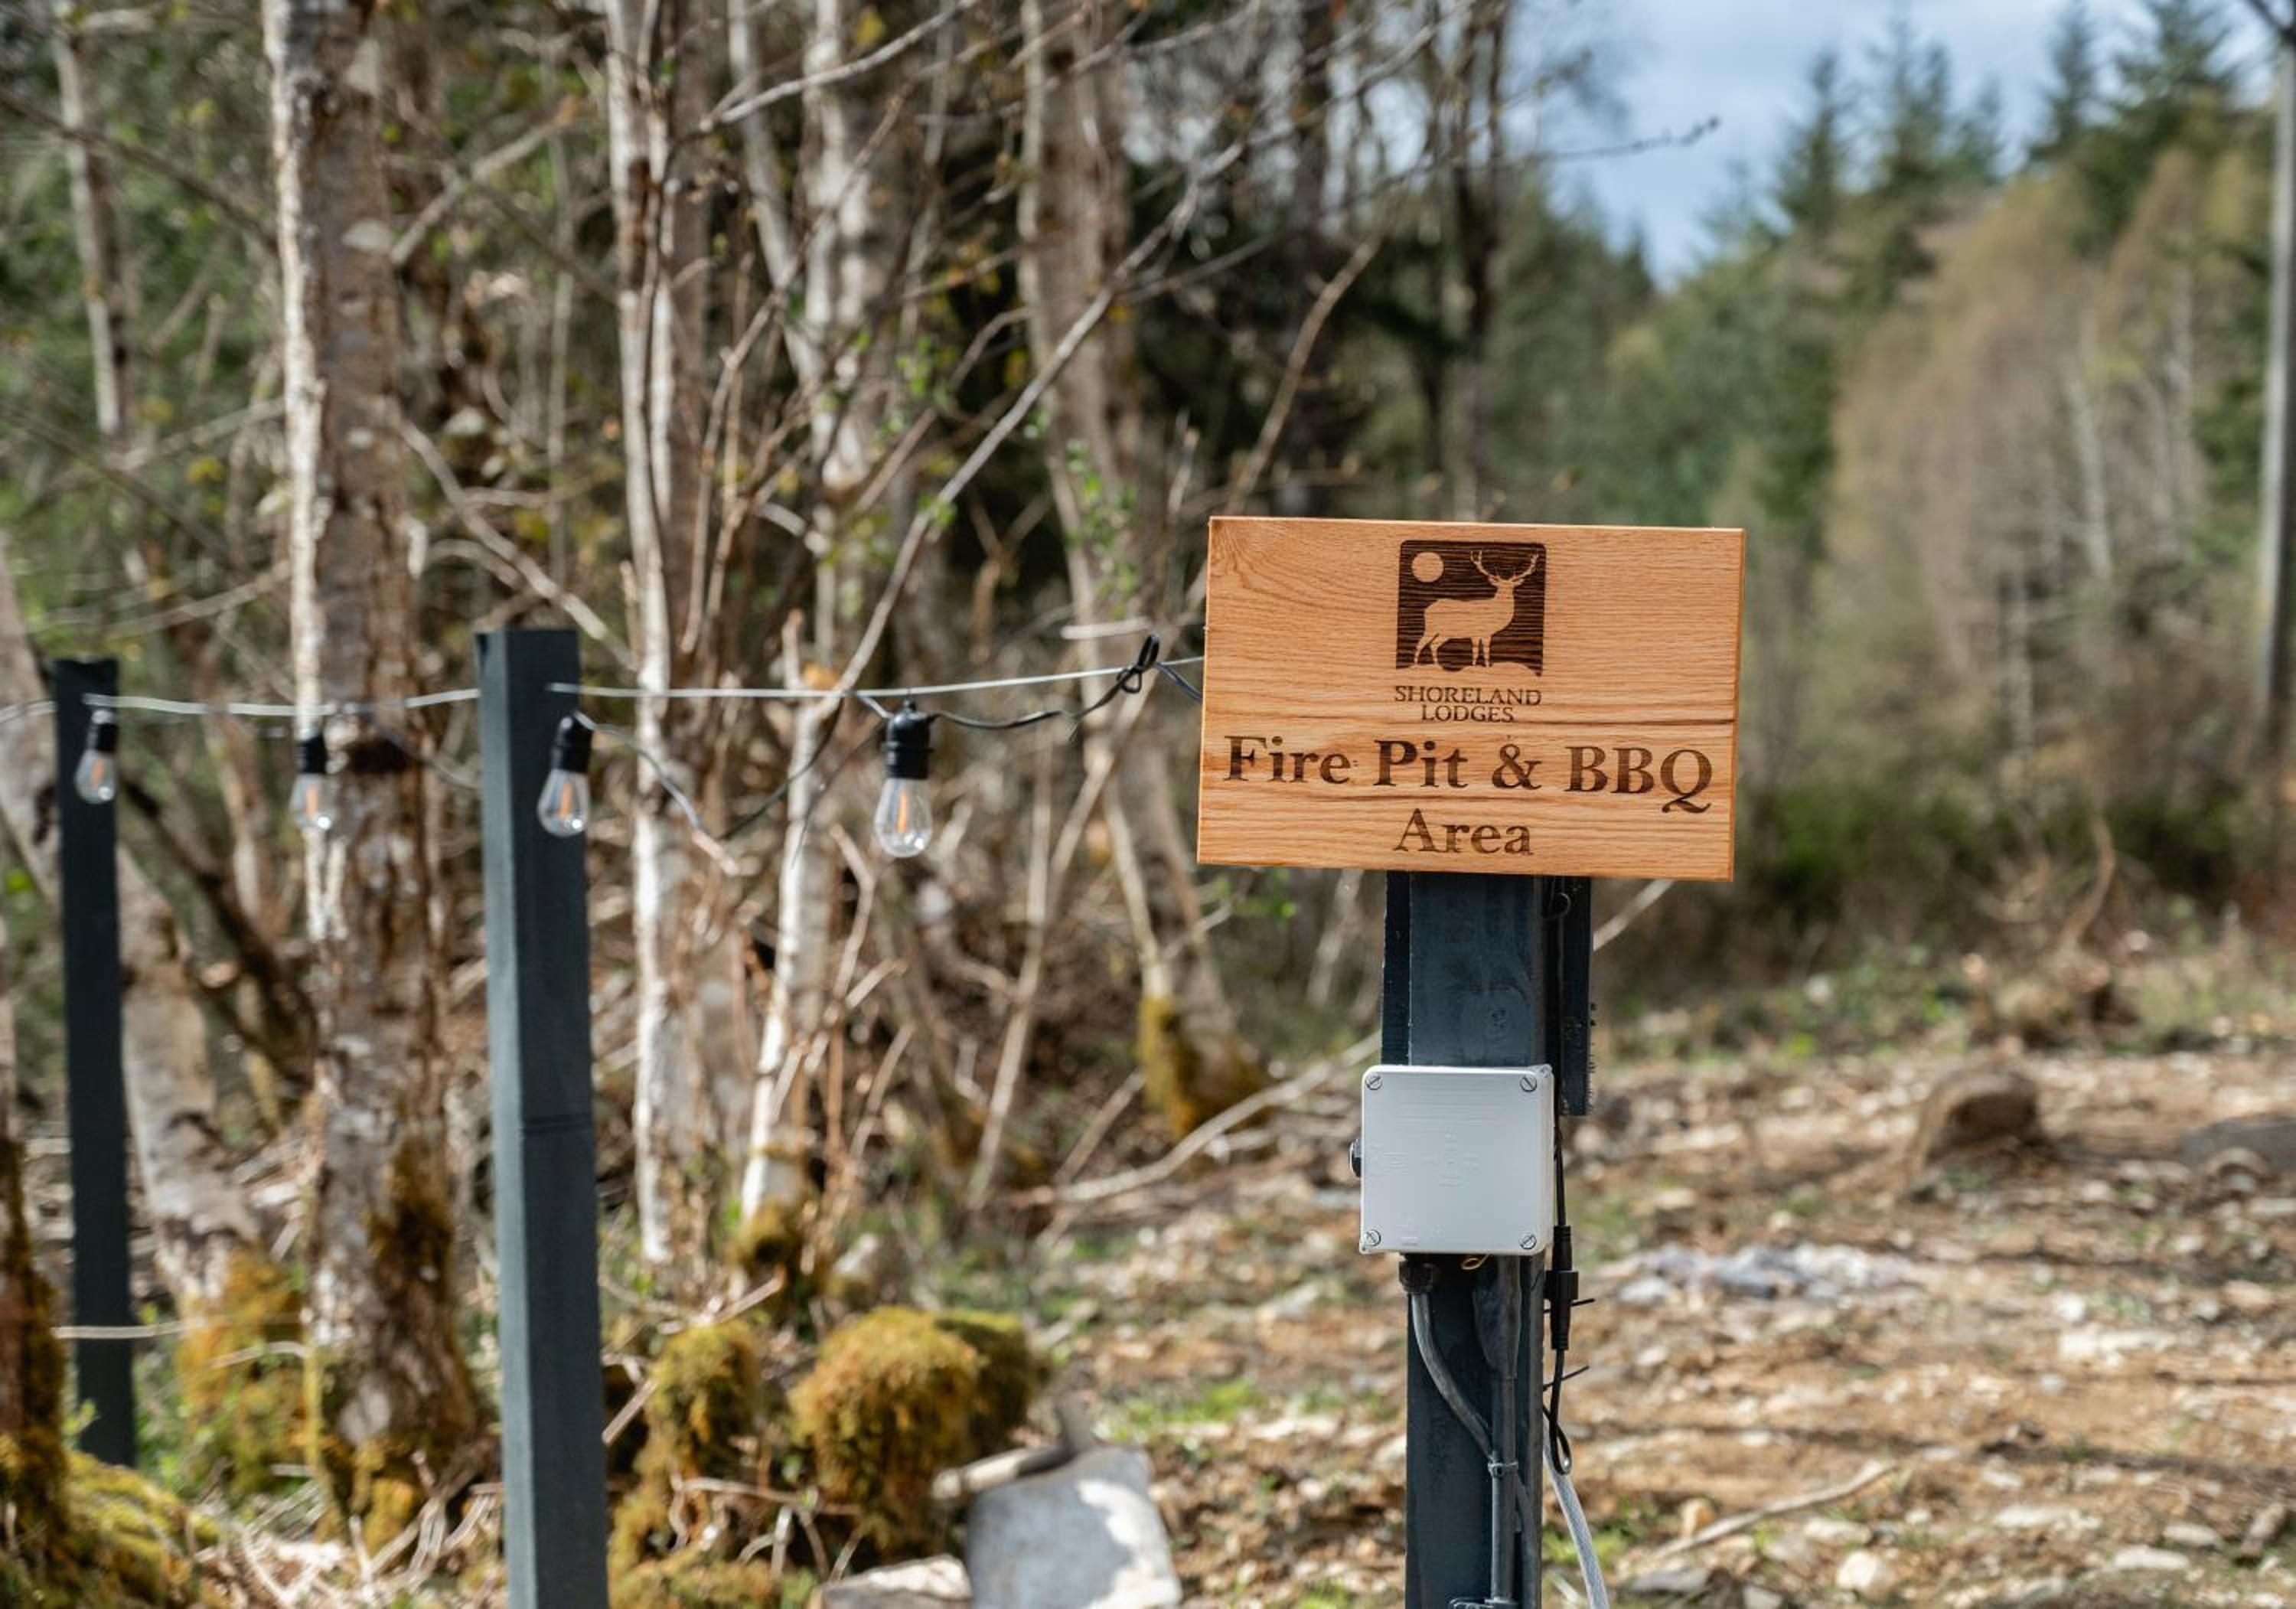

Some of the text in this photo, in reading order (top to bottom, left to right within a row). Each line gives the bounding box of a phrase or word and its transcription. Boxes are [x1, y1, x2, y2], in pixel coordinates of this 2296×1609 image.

[1394, 684, 1542, 706] SHORELAND
[1421, 704, 1514, 723] LODGES
[1223, 735, 1712, 814] Fire Pit & BBQ
[1394, 808, 1534, 856] Area
